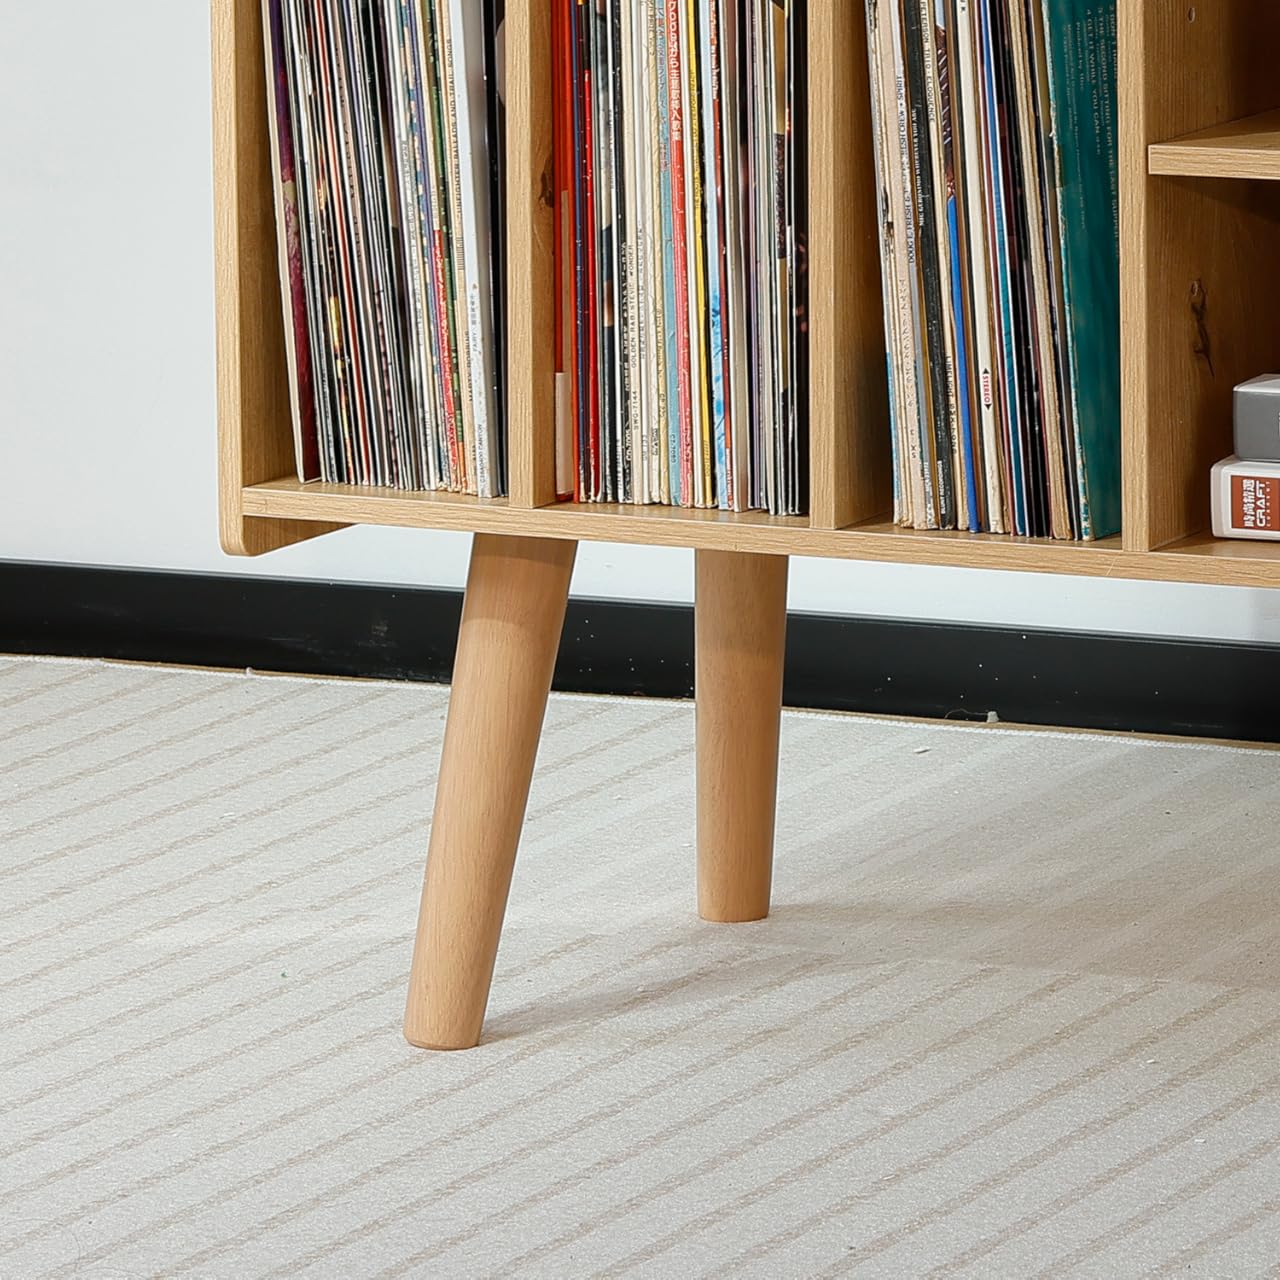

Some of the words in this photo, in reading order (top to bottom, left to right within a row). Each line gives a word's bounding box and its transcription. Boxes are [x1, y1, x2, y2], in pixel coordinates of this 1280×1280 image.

[919, 1, 929, 43] PETERSON
[923, 48, 931, 69] TRIO
[895, 74, 903, 100] SPIRIT
[926, 76, 936, 122] ELOQUENCE
[936, 460, 944, 495] RECORDINGS
[1256, 480, 1265, 527] CRAFT
